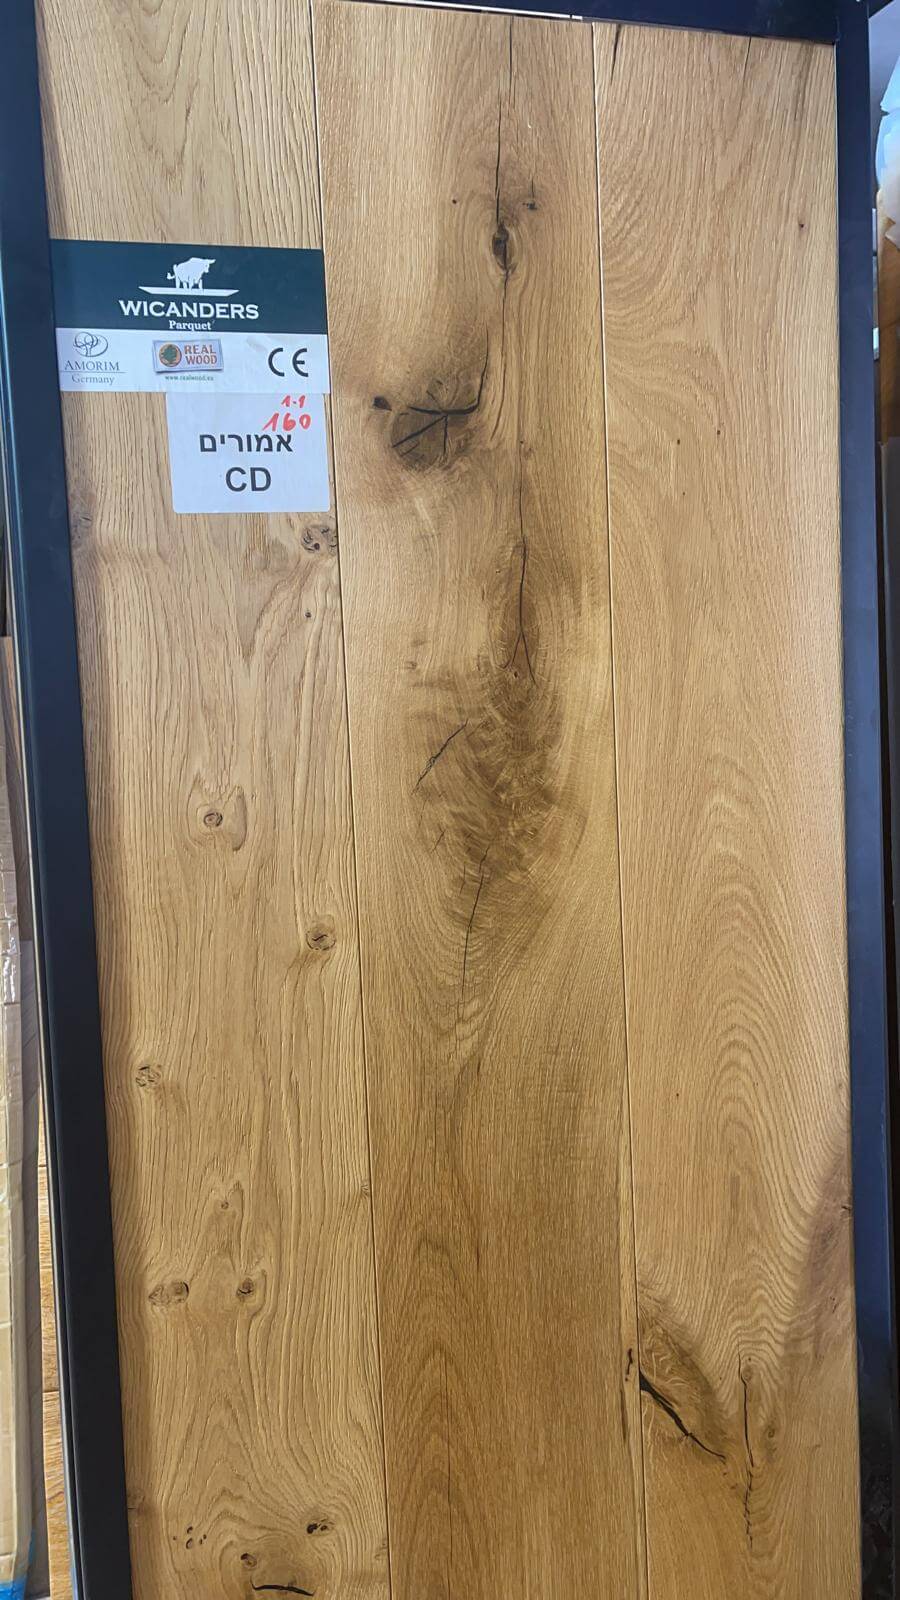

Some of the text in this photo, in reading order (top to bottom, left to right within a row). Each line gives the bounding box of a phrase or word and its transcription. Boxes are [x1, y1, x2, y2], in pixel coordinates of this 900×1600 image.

[118, 299, 259, 320] WICANDERS
[168, 319, 212, 332] Parquet
[184, 344, 217, 354] REAL
[64, 360, 121, 371] AMORIM
[185, 354, 218, 365] WOOD
[71, 374, 115, 385] Germany
[262, 412, 311, 431] 160
[199, 434, 293, 452] אמורים
[225, 467, 272, 492] CD
